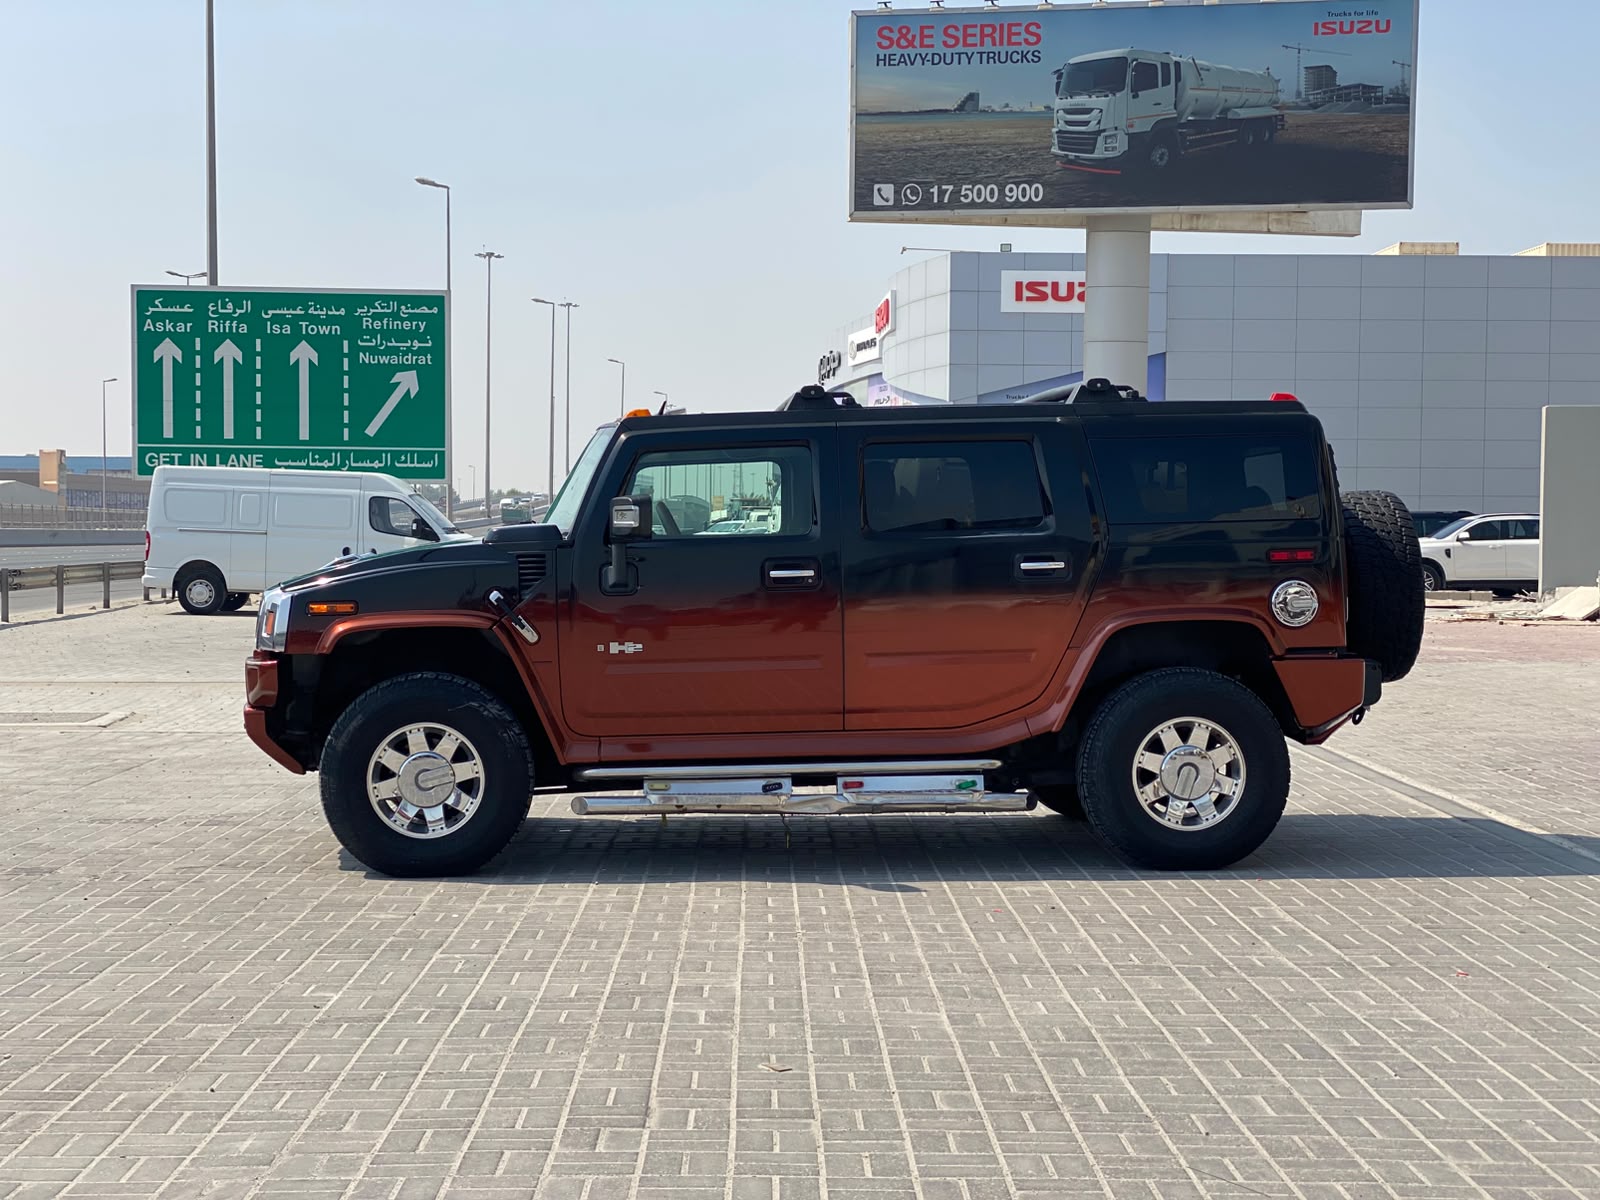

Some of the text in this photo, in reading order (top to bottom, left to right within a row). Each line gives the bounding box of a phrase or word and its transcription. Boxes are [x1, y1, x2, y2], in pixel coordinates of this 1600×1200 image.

[1366, 9, 1379, 17] life
[1313, 19, 1391, 36] ISUZU
[876, 22, 1042, 50] S&E SERIES
[876, 50, 1042, 67] HEAVY-DUTY TRUCKS
[929, 183, 1044, 203] 17 500 900
[144, 298, 194, 316] عسكر
[208, 298, 251, 317] الرفاع
[261, 302, 346, 319] مدينة عيسى
[354, 300, 438, 317] مصنع التكرير
[143, 319, 193, 333] Askar
[208, 320, 248, 334] Riffa
[267, 321, 341, 335] Isa Town
[362, 317, 427, 333] Refinery
[357, 334, 432, 350] نويدرات
[359, 352, 432, 365] Nuwaidrat
[145, 453, 263, 468] GET IN LANE
[274, 453, 438, 472] اسلك المسار المناسب
[609, 641, 643, 655] H2
